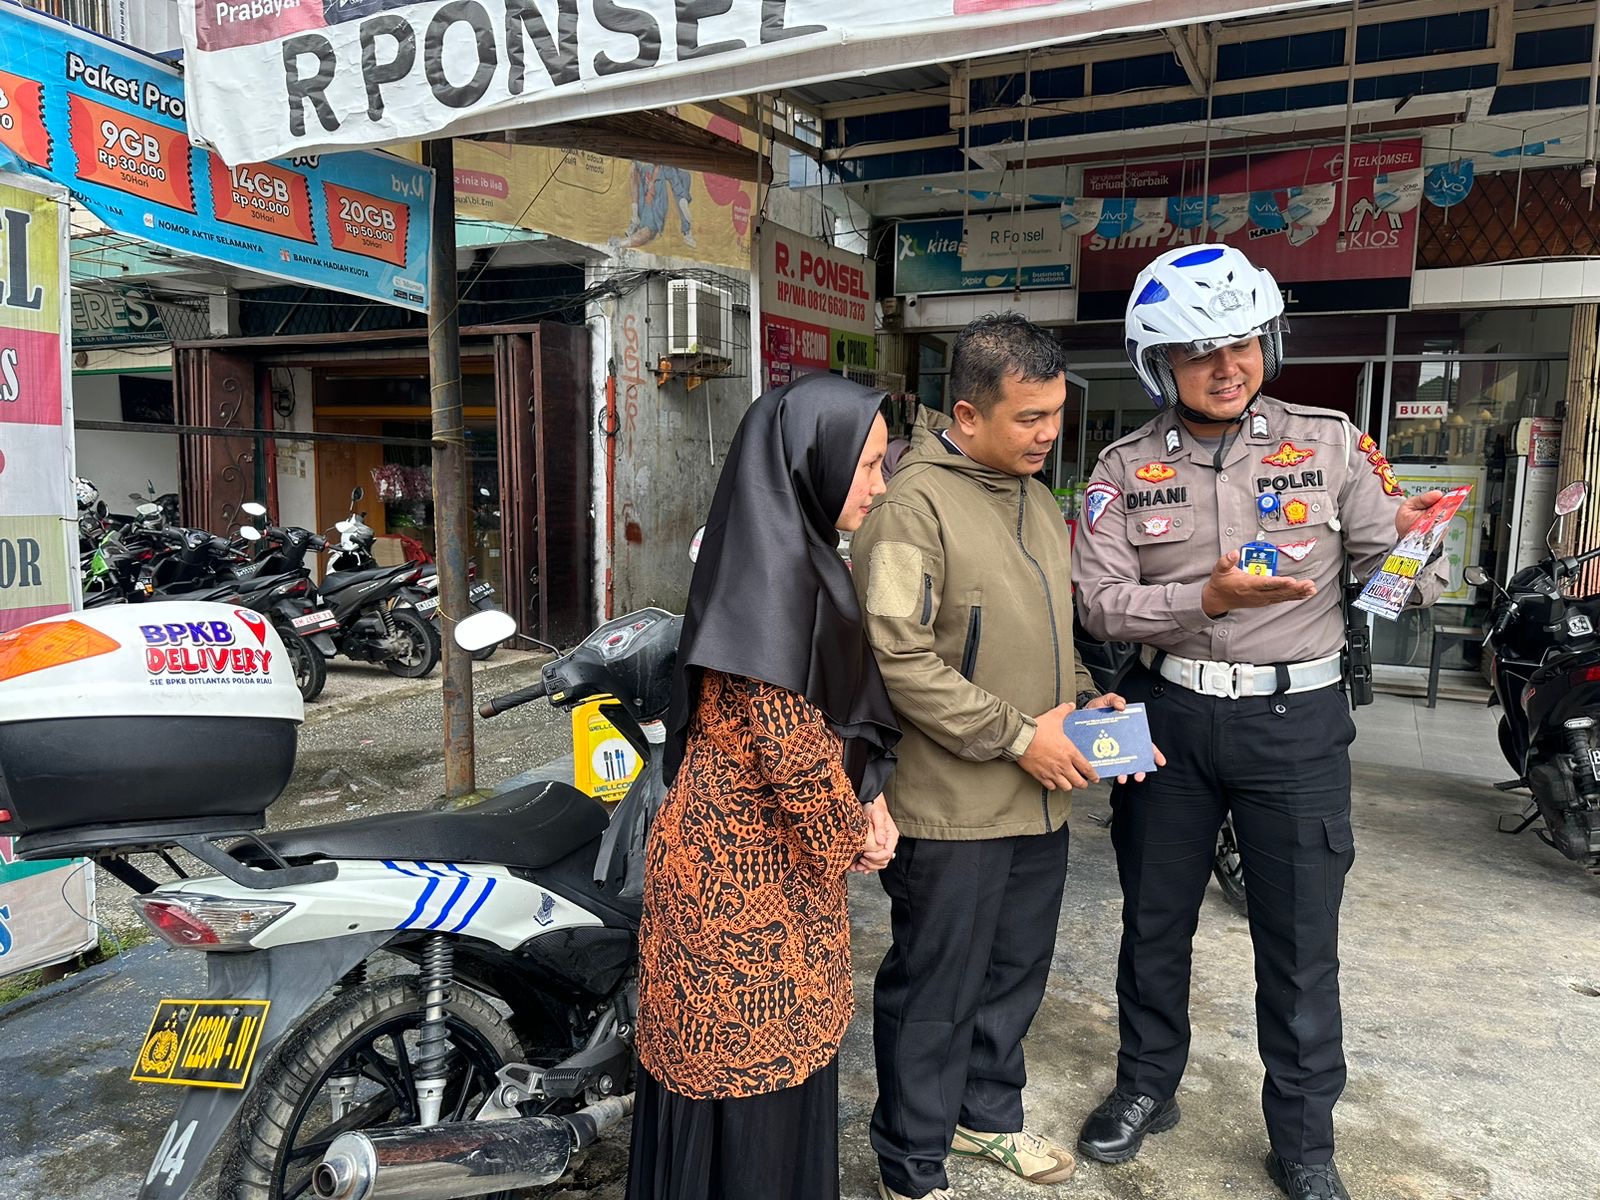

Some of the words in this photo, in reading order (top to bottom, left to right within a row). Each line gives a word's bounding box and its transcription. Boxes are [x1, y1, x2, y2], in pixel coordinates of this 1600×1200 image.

[67, 52, 140, 103] Paket
[144, 83, 187, 121] Pro
[282, 34, 342, 137] R
[100, 120, 161, 163] 9GB
[98, 150, 118, 169] Rp
[120, 158, 165, 181] 30.000
[1353, 153, 1414, 168] TELKOMSEL
[120, 172, 149, 188] 30Hari
[229, 167, 289, 203] 14GB
[1132, 176, 1169, 188] Terbaik
[232, 191, 249, 207] Rp
[251, 198, 290, 216] 40.000
[339, 197, 396, 230] 20GB
[1100, 211, 1127, 221] vivo
[1255, 202, 1279, 212] viv
[251, 210, 275, 223] 30Hari
[159, 220, 190, 236] NOMOR
[191, 228, 216, 243] AKTIF
[216, 236, 264, 254] SELAMANYA
[346, 222, 359, 237] Rp
[360, 227, 394, 242] 50.000
[362, 238, 383, 249] 30Hari
[989, 230, 1000, 245] R
[1350, 230, 1399, 247] KIOS
[0, 208, 43, 310] L
[293, 253, 322, 269] BANYAK
[323, 260, 349, 273] HADIAH
[349, 265, 369, 278] KUOTA
[775, 241, 796, 279] R.
[801, 250, 870, 300] PONSEL
[778, 280, 807, 307] HP/WA
[809, 289, 827, 313] 0812
[828, 295, 849, 319] 6630
[849, 301, 866, 322] 7373
[801, 330, 828, 361] SECOND
[0, 348, 20, 403] S
[1400, 405, 1443, 415] BUKA
[1257, 470, 1323, 492] POLRI
[1126, 487, 1187, 509] DHANI
[139, 621, 235, 646] BPKB
[146, 647, 272, 675] DELIVERY
[189, 677, 231, 685] DITLANTAS
[232, 677, 255, 685] POLDA
[256, 677, 273, 685] RIAU
[589, 723, 614, 732] WELLC
[181, 1016, 258, 1069] 122304-IV
[146, 1120, 198, 1186] 04
